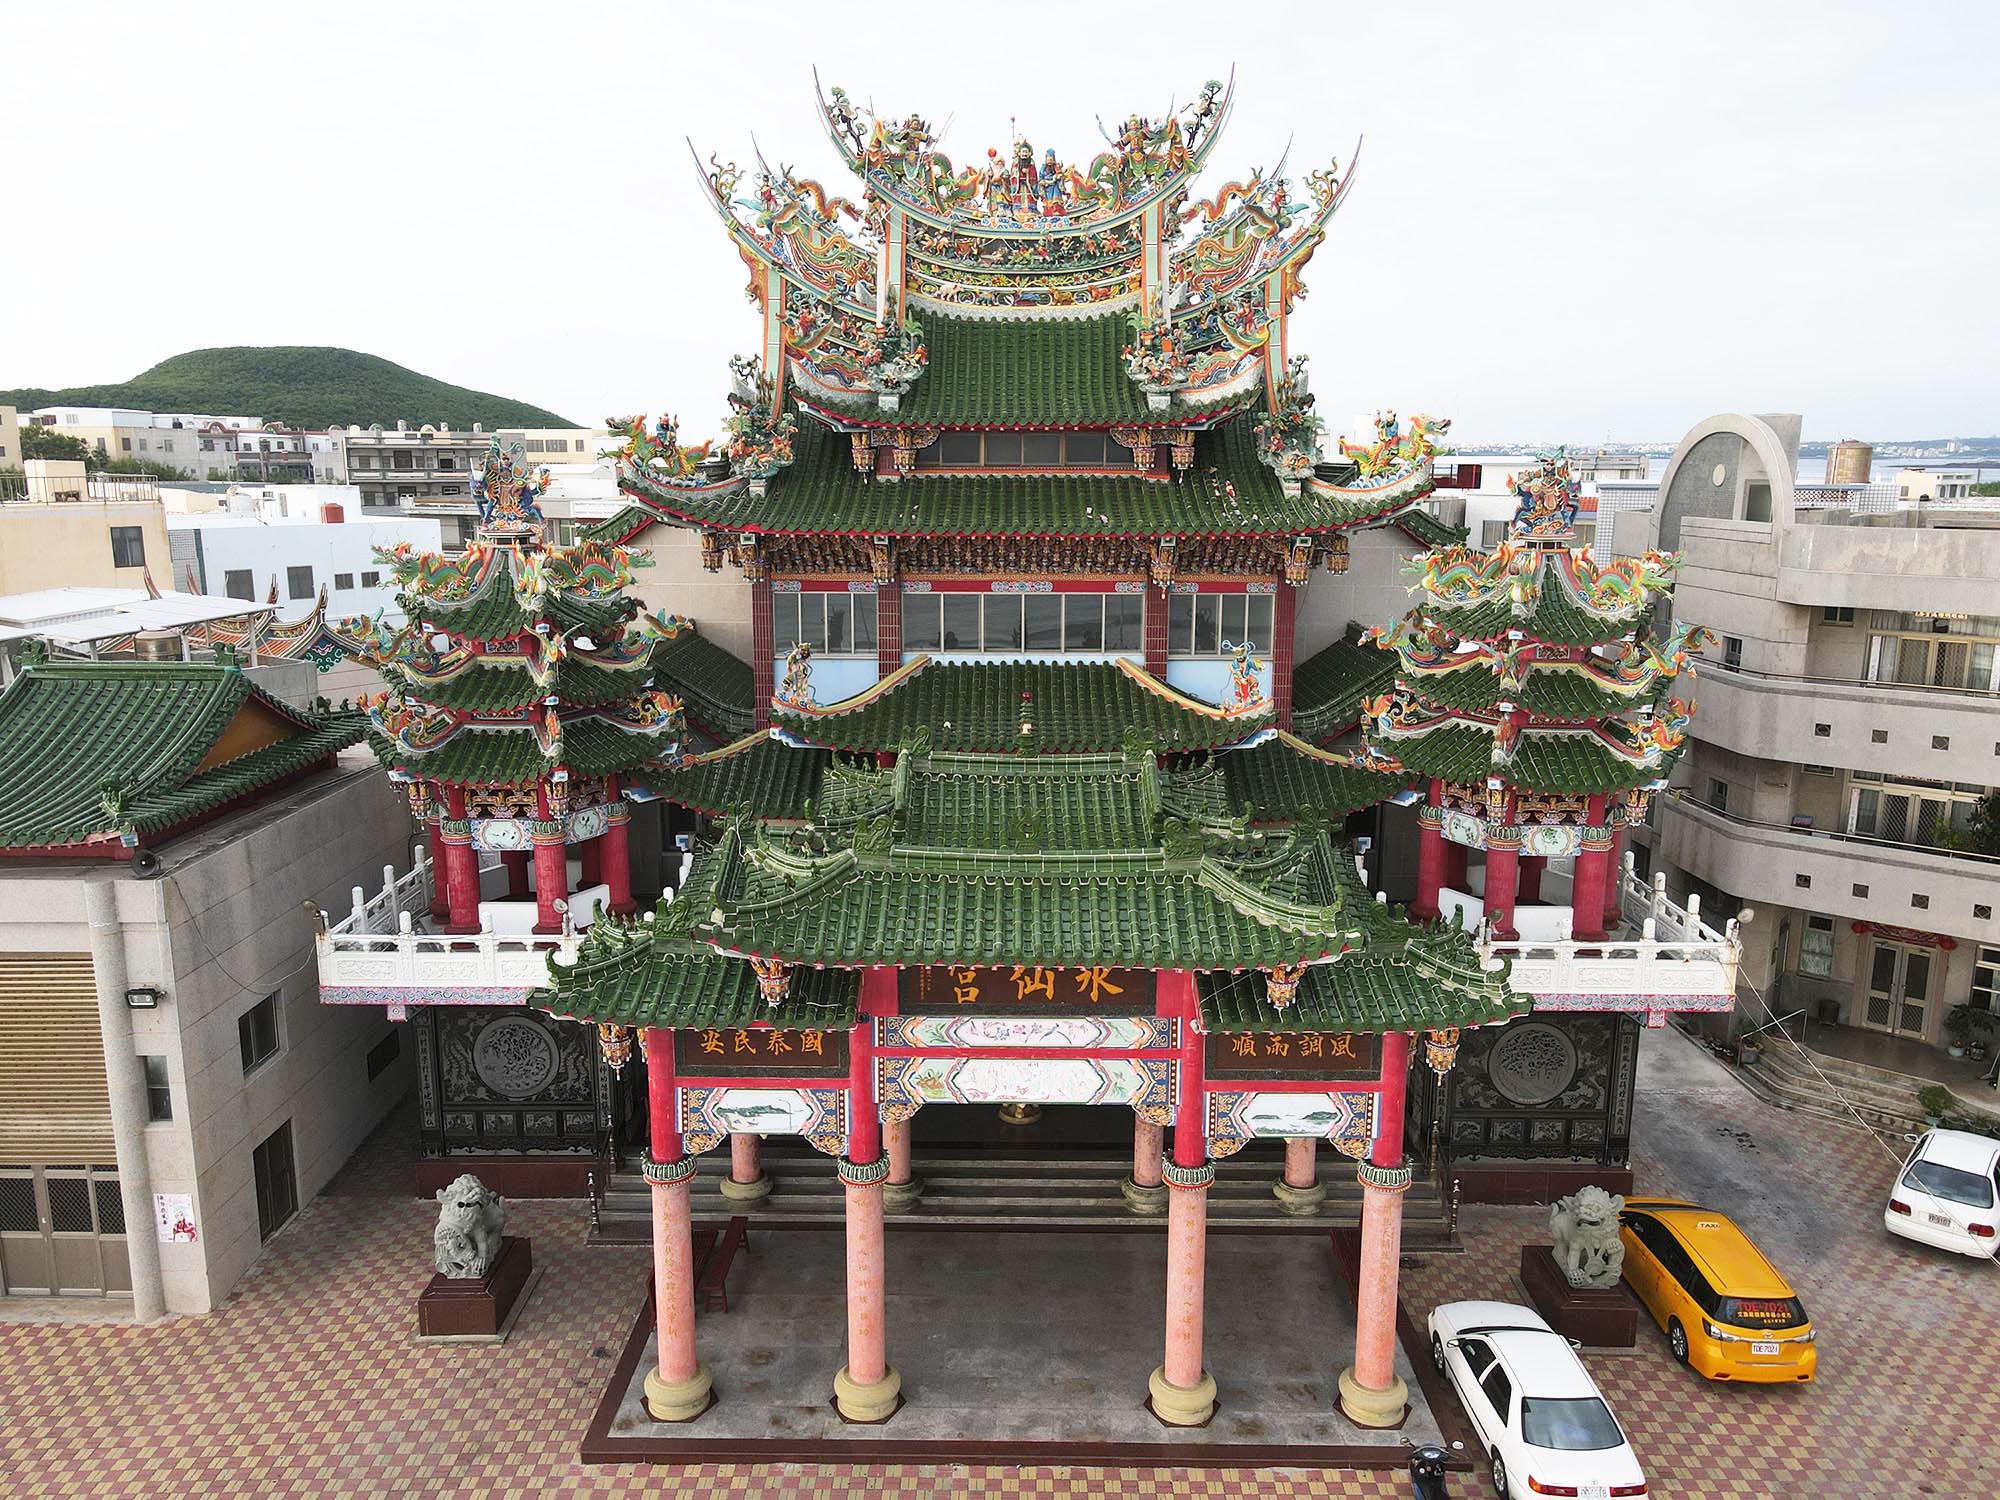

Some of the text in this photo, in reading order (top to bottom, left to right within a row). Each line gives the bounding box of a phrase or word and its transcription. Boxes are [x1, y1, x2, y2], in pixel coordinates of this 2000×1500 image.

[700, 1030, 824, 1056] 國泰民安
[1232, 1034, 1357, 1059] 風調雨順
